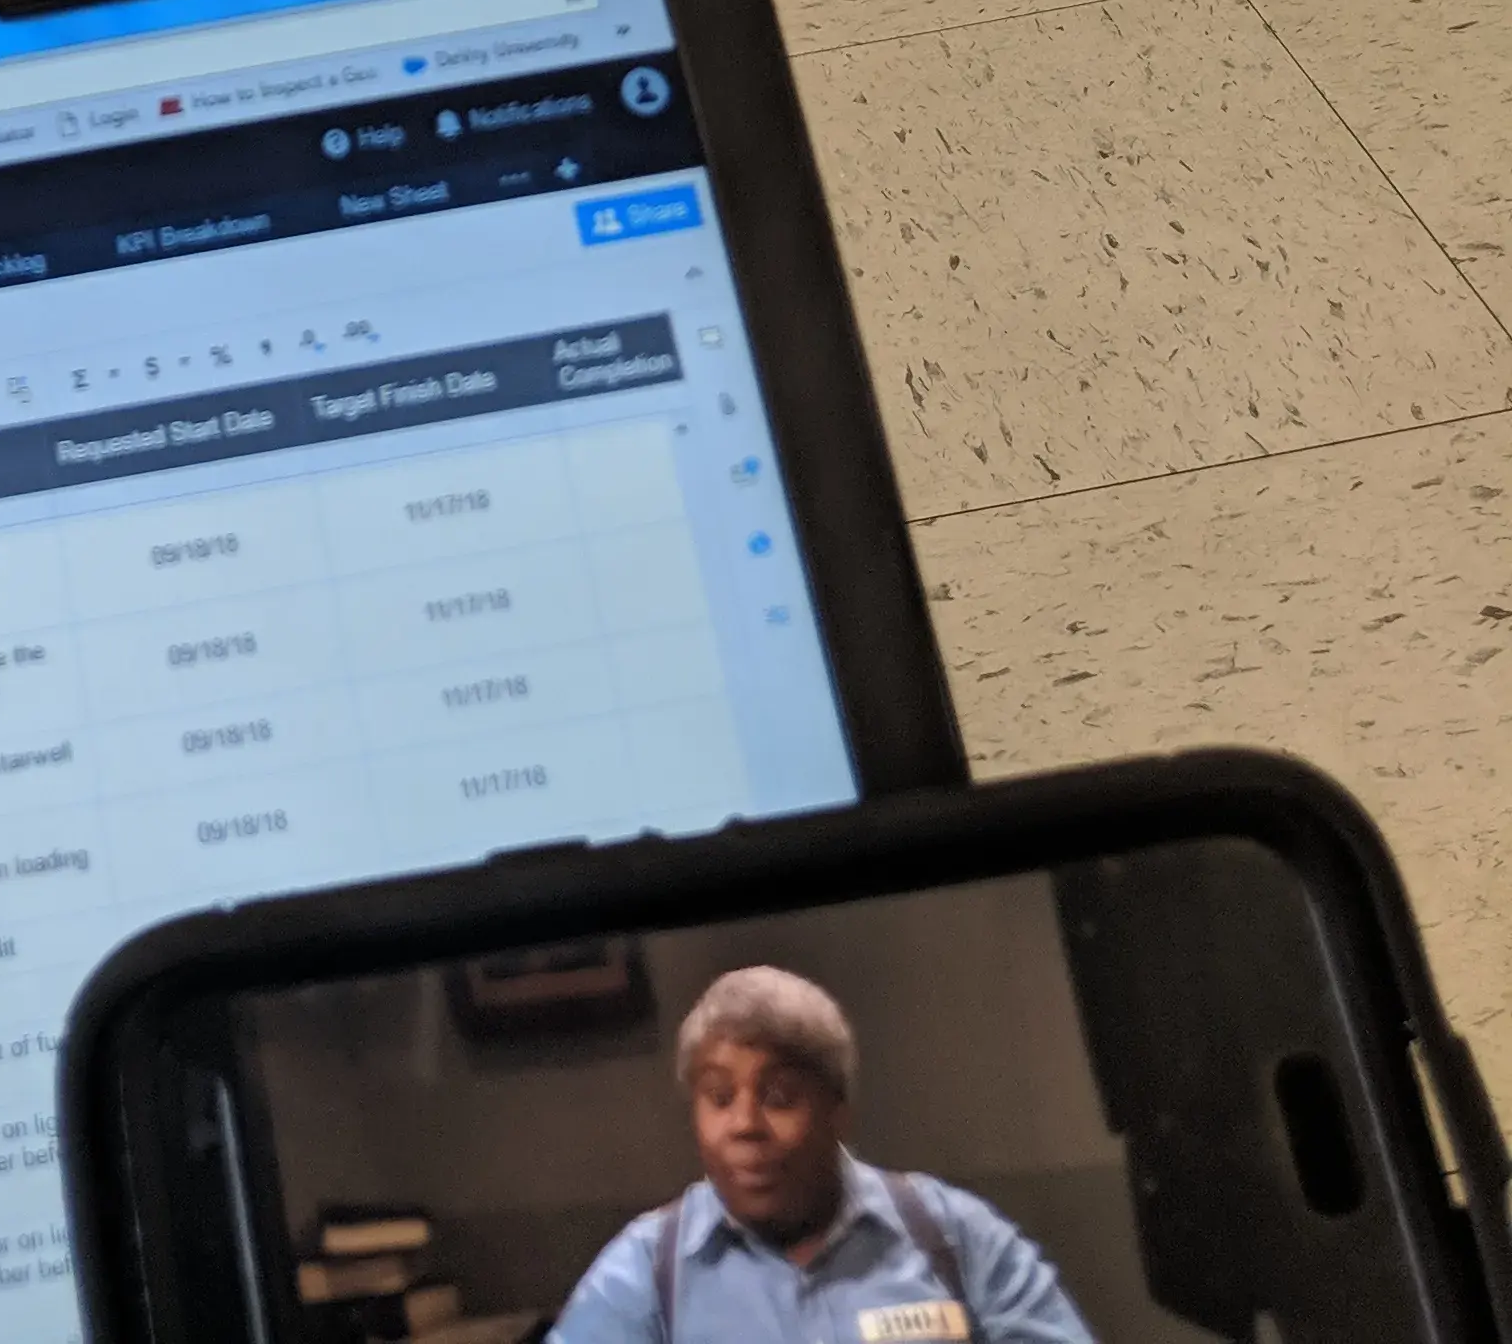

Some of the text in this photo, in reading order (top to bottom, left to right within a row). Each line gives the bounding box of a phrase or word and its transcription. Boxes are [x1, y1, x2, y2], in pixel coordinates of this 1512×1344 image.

[552, 330, 621, 361] Actual
[558, 353, 674, 390] Completion
[309, 370, 497, 417] Target Finish Date
[56, 409, 274, 461] Requested Start Date
[15, 849, 89, 875] loading
[10, 1033, 29, 1058] of
[1, 1120, 28, 1139] on
